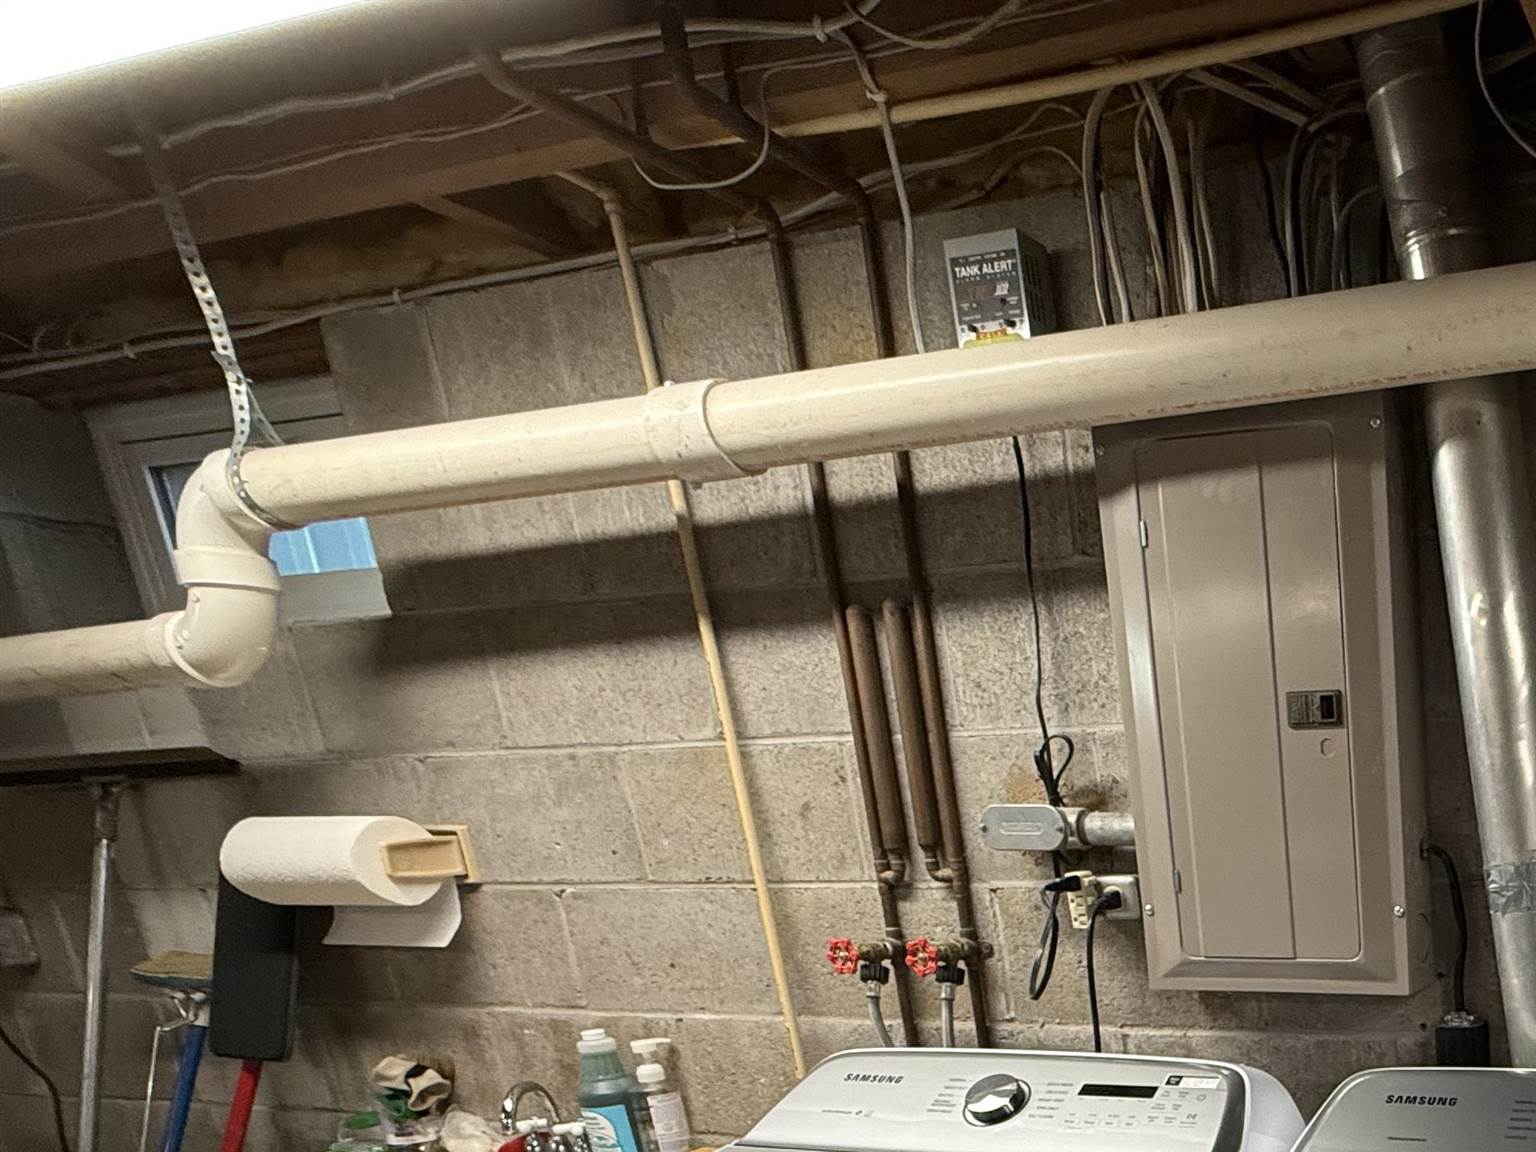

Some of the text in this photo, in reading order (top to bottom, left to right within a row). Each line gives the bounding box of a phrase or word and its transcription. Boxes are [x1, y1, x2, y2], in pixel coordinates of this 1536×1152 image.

[954, 264, 982, 279] TANK
[982, 259, 1013, 274] ALERT
[844, 1073, 904, 1084] SAMSUNG
[1385, 1094, 1459, 1107] SAMSUNG
